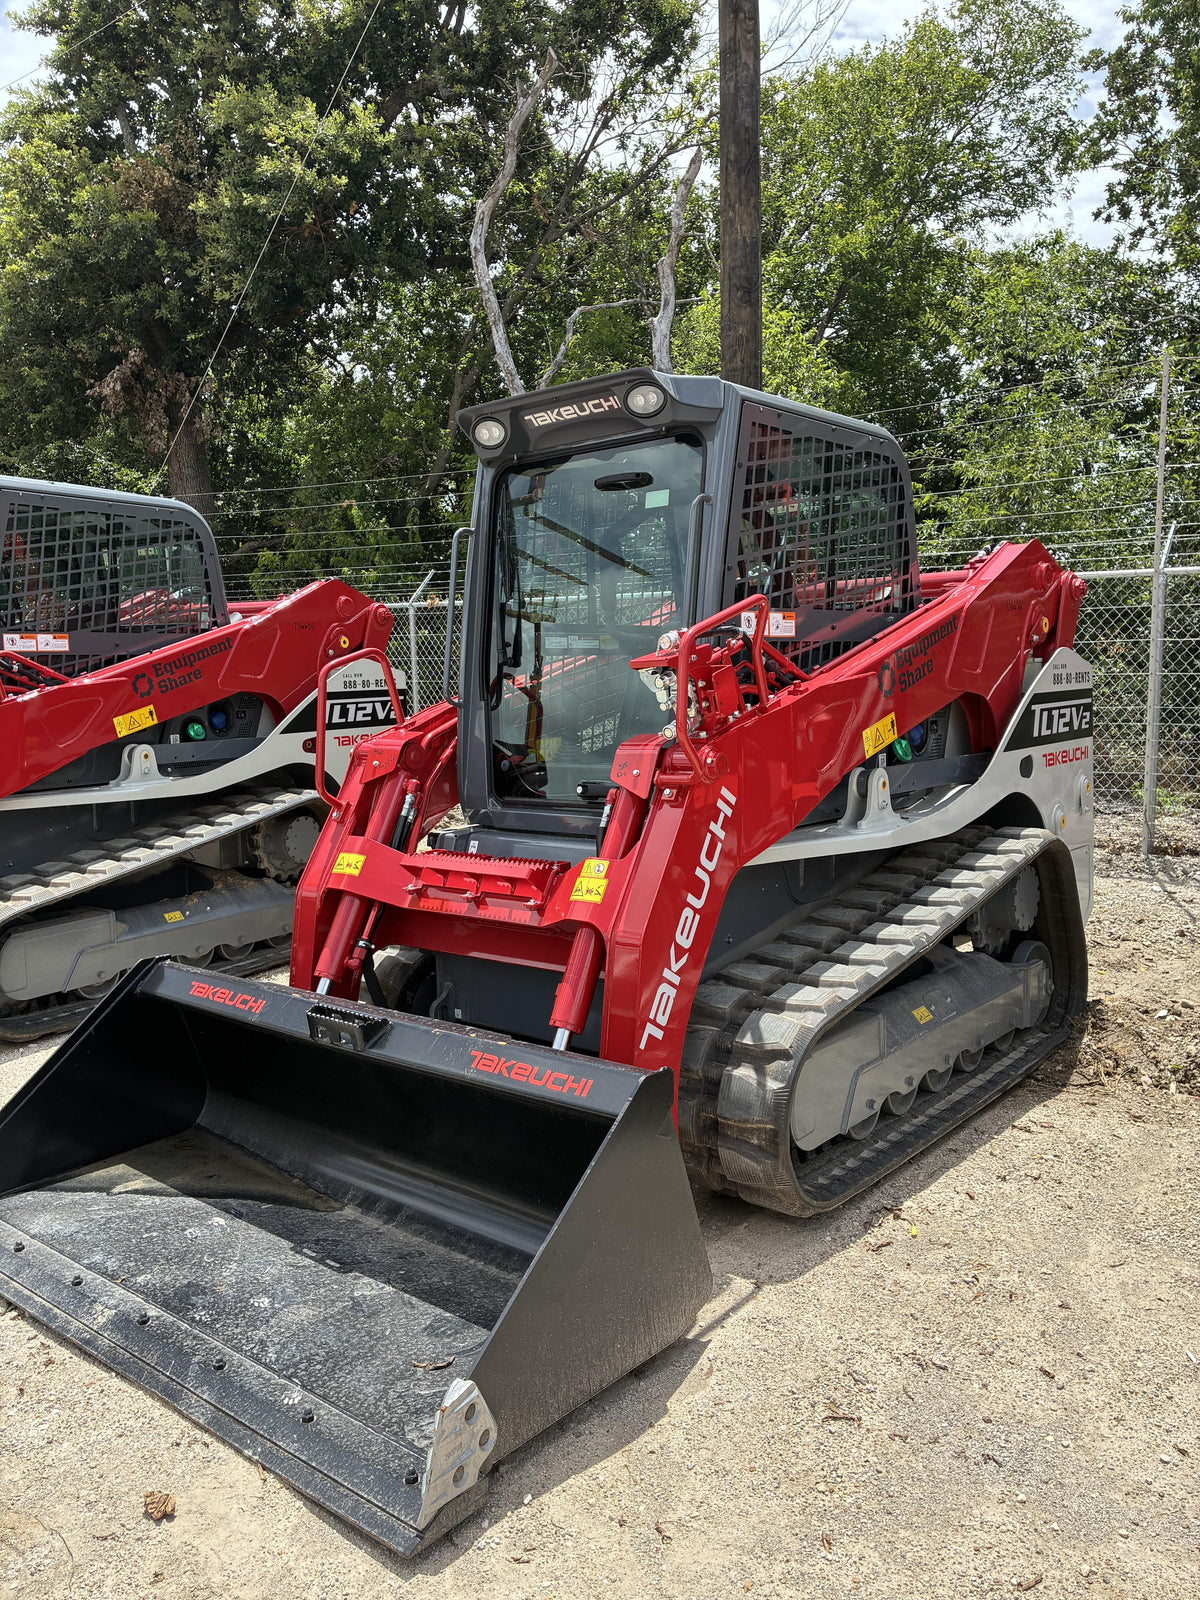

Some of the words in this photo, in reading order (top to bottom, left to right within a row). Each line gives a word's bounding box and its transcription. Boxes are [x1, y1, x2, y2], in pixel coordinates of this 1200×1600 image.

[524, 395, 622, 427] TAKEUCHI
[151, 637, 233, 678] Equipment
[894, 614, 958, 670] Equipment
[157, 667, 202, 694] Share
[897, 658, 934, 693] Share
[1053, 671, 1091, 685] 888-80-RENTS
[1031, 698, 1092, 738] TL12V2
[1042, 745, 1089, 768] TAKEUCHI
[639, 785, 738, 1051] TAKEUCHI
[190, 979, 267, 1015] TAKEUCHI
[469, 1049, 594, 1099] TAKEUCHI
